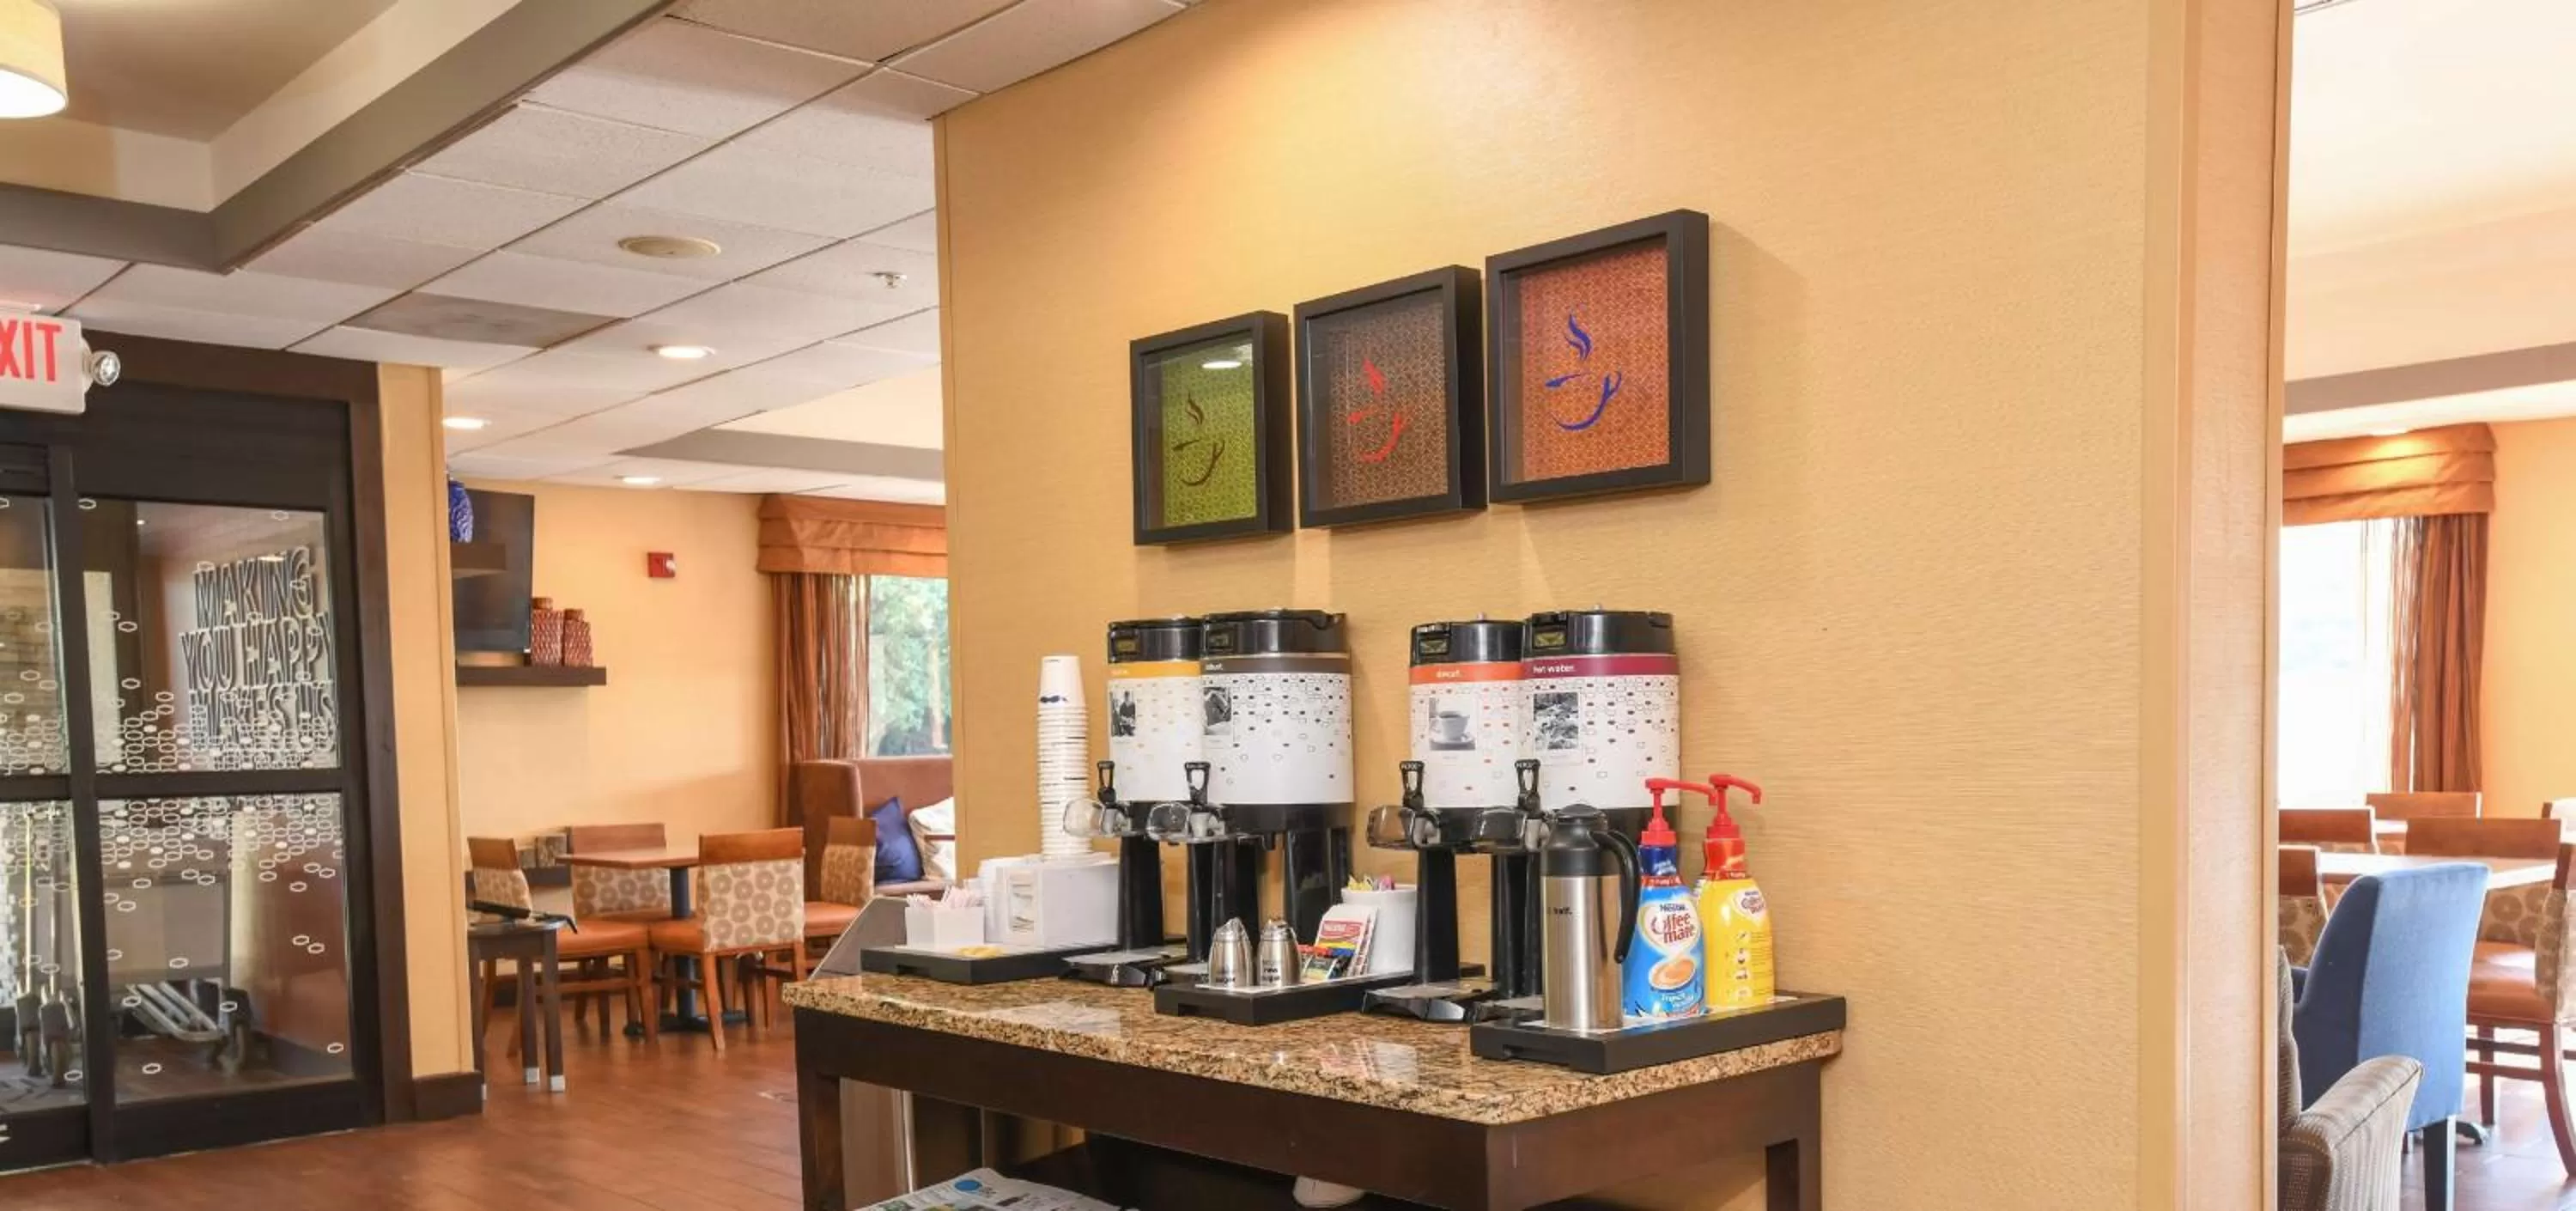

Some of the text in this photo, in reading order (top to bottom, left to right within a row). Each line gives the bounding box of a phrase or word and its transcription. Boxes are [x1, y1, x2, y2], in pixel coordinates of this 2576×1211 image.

[193, 545, 315, 630] MAKING
[179, 612, 335, 694] YOU HAPPY
[1650, 912, 1691, 935] Coffee
[1663, 924, 1696, 943] mate
